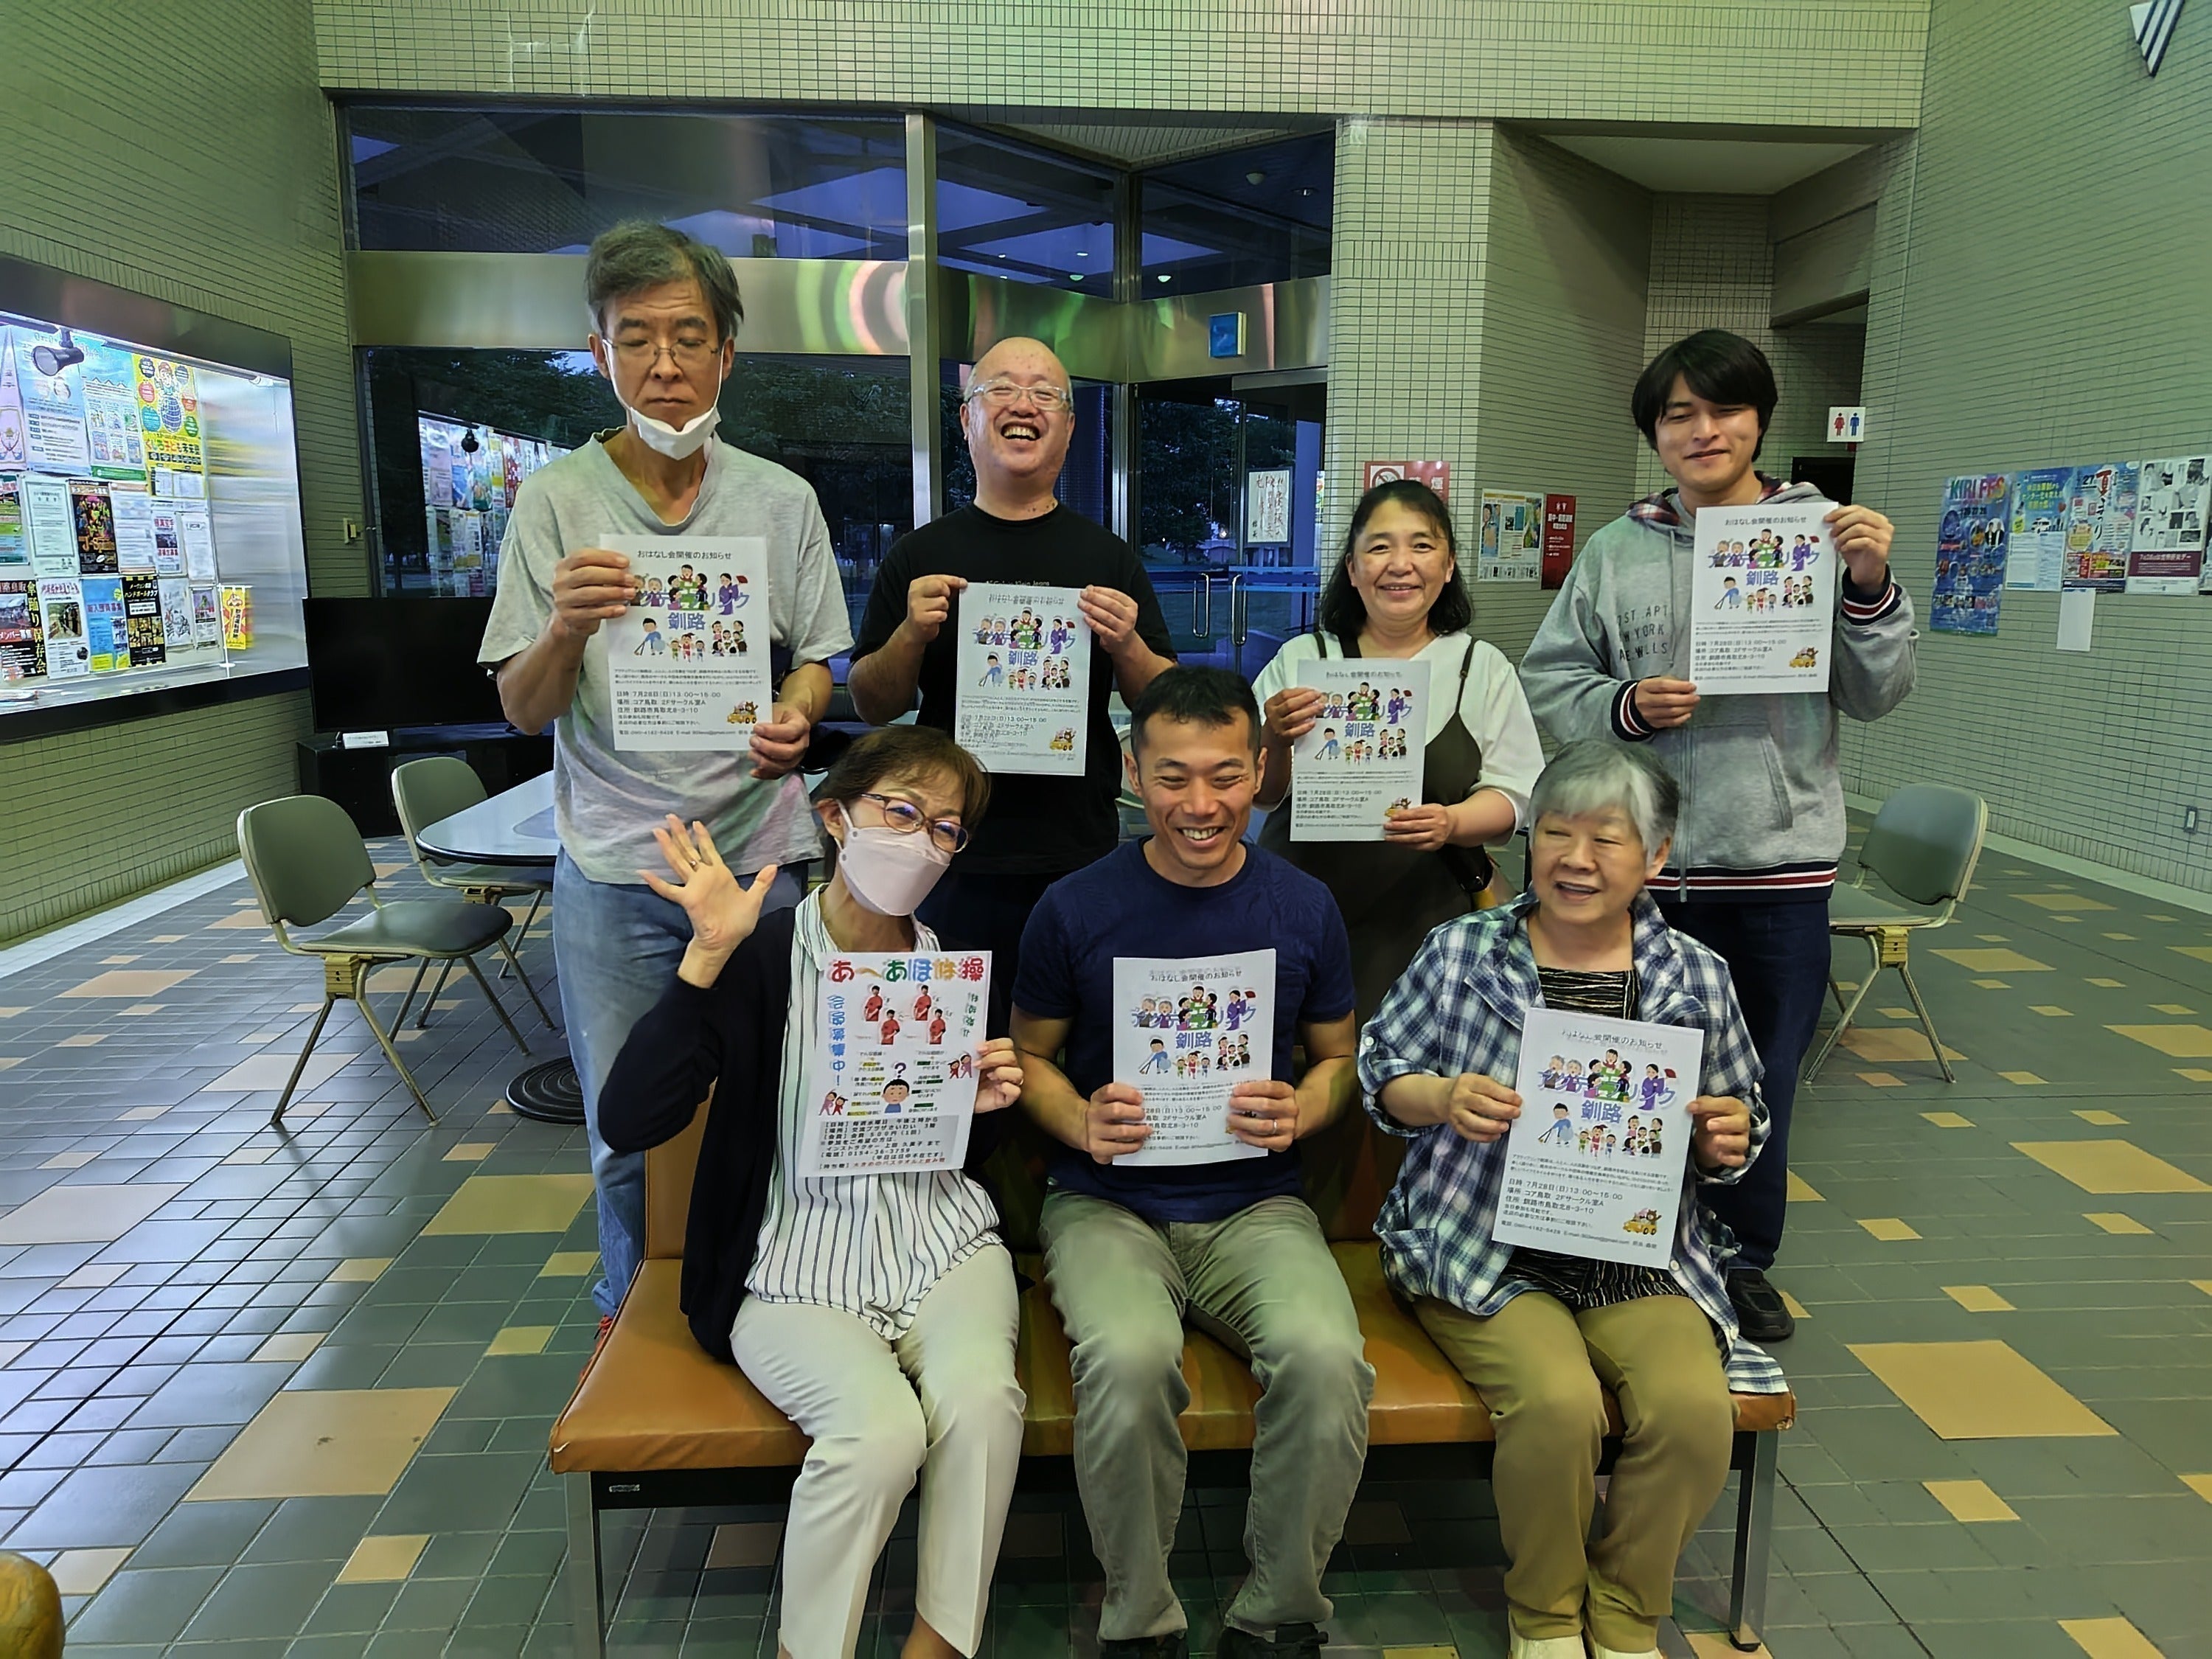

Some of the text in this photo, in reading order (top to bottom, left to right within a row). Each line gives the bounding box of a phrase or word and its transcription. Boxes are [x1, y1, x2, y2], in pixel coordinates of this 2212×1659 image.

[1725, 517, 1806, 526] おはなし会開催のお知らせ
[638, 550, 731, 560] おはなし会開催のお知らせ
[1746, 570, 1779, 586] 釧路
[0, 582, 27, 593] 路鳥取
[668, 613, 706, 630] 釧路
[1635, 623, 1664, 639] YORK
[1008, 650, 1038, 667] 釧路
[1345, 723, 1375, 737] 釧路
[1150, 970, 1242, 982] おはなし会開催のお知らせ
[1175, 1032, 1213, 1049] 釧路
[1581, 1099, 1622, 1124] 釧路
[1525, 1189, 1551, 1199] コア鳥取
